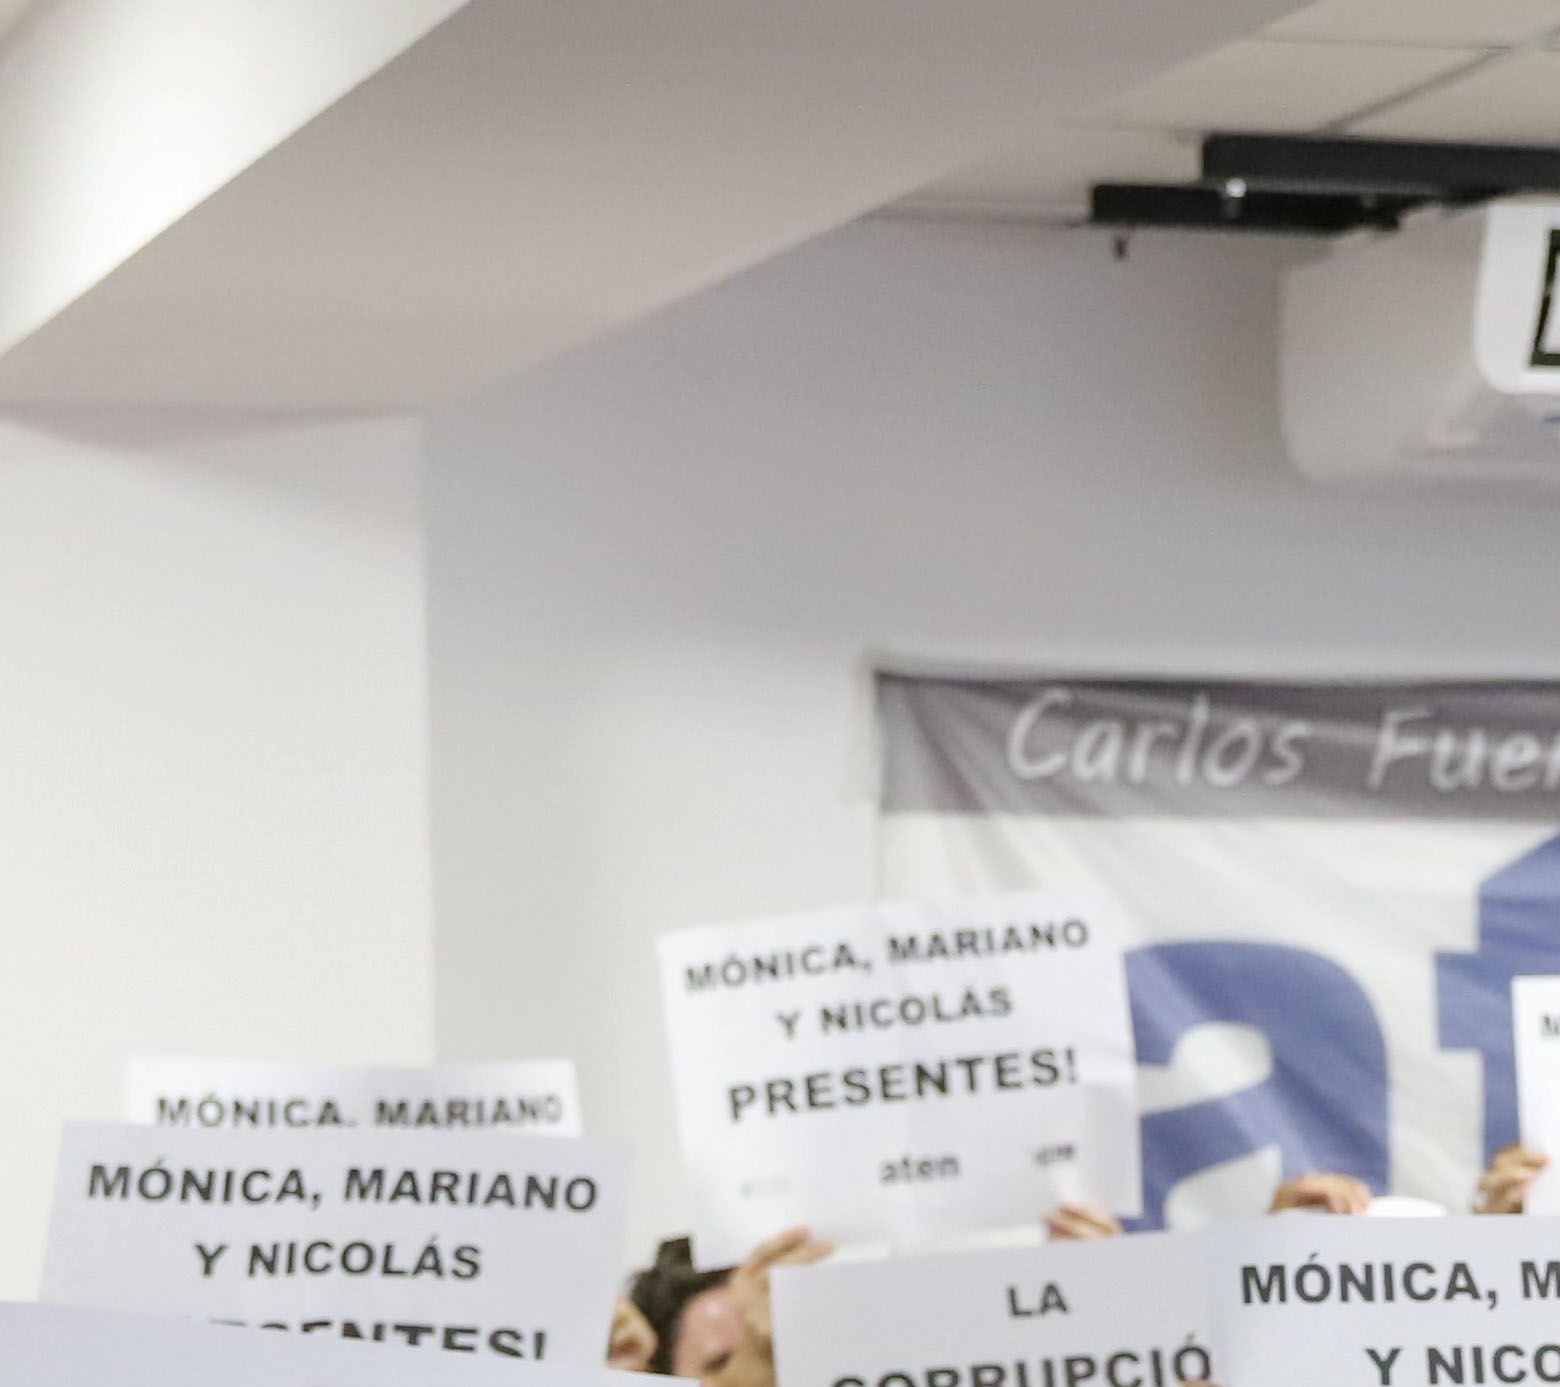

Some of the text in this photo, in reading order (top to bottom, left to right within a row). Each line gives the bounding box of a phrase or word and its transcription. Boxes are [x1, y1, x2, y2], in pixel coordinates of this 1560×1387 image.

[1002, 693, 1307, 789] Carlos
[685, 919, 1088, 991] MÓNICA, MARIANO
[776, 986, 1013, 1040] Y NICOLÁS
[728, 1048, 1076, 1121] PRESENTES!
[374, 1095, 560, 1128] MARIANO
[89, 1160, 597, 1212] MÓNICA, MARIANO
[880, 1155, 960, 1185] aten
[194, 1238, 480, 1280] Y NICOLÁS
[1241, 1253, 1497, 1310] MÓNICA,
[1007, 1282, 1069, 1318] LA
[1365, 1348, 1402, 1387] Y
